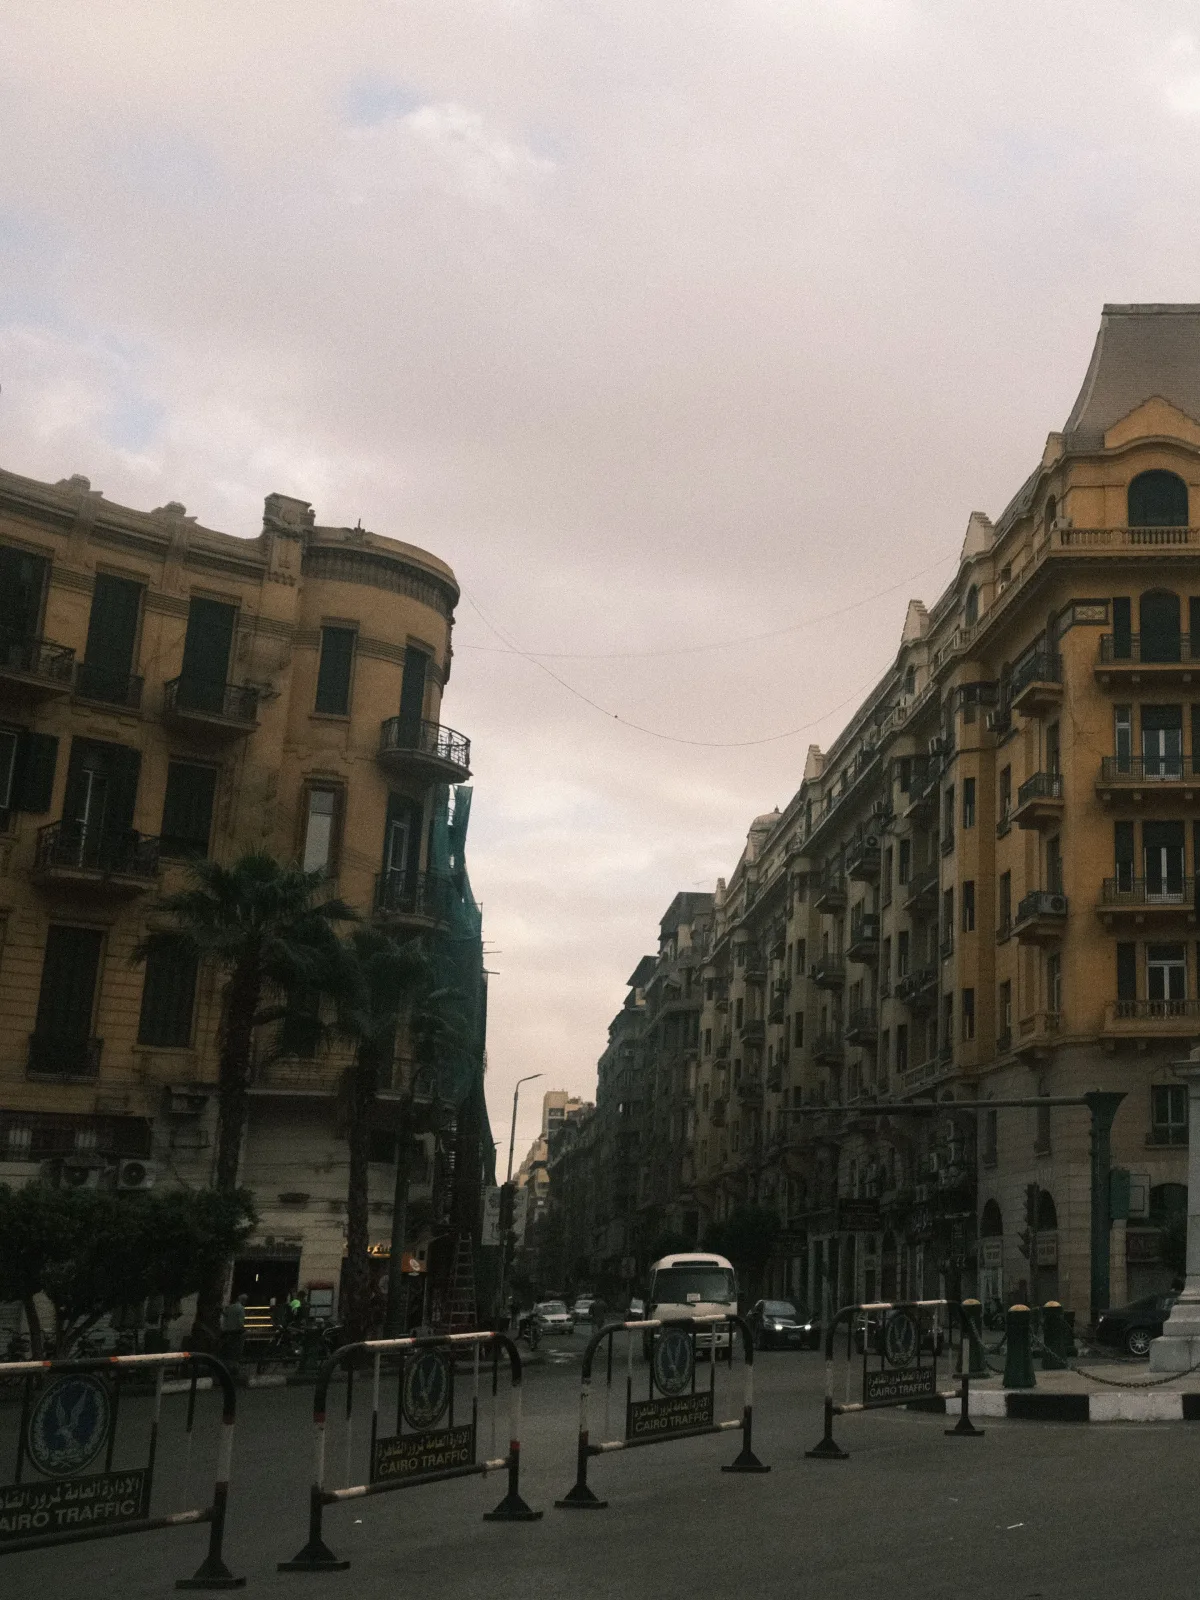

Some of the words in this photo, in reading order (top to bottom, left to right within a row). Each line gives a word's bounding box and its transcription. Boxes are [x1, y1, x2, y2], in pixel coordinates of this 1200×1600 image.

[869, 1385, 897, 1398] CAIRO
[898, 1382, 931, 1395] TRAFFIC
[635, 1417, 668, 1433] CAIRO
[669, 1411, 709, 1427] TRAFFIC
[379, 1457, 418, 1475] CAIRO
[421, 1448, 468, 1467] TRAFFIC
[0, 1511, 50, 1532] AIRO
[55, 1500, 136, 1524] TRAFFIC
